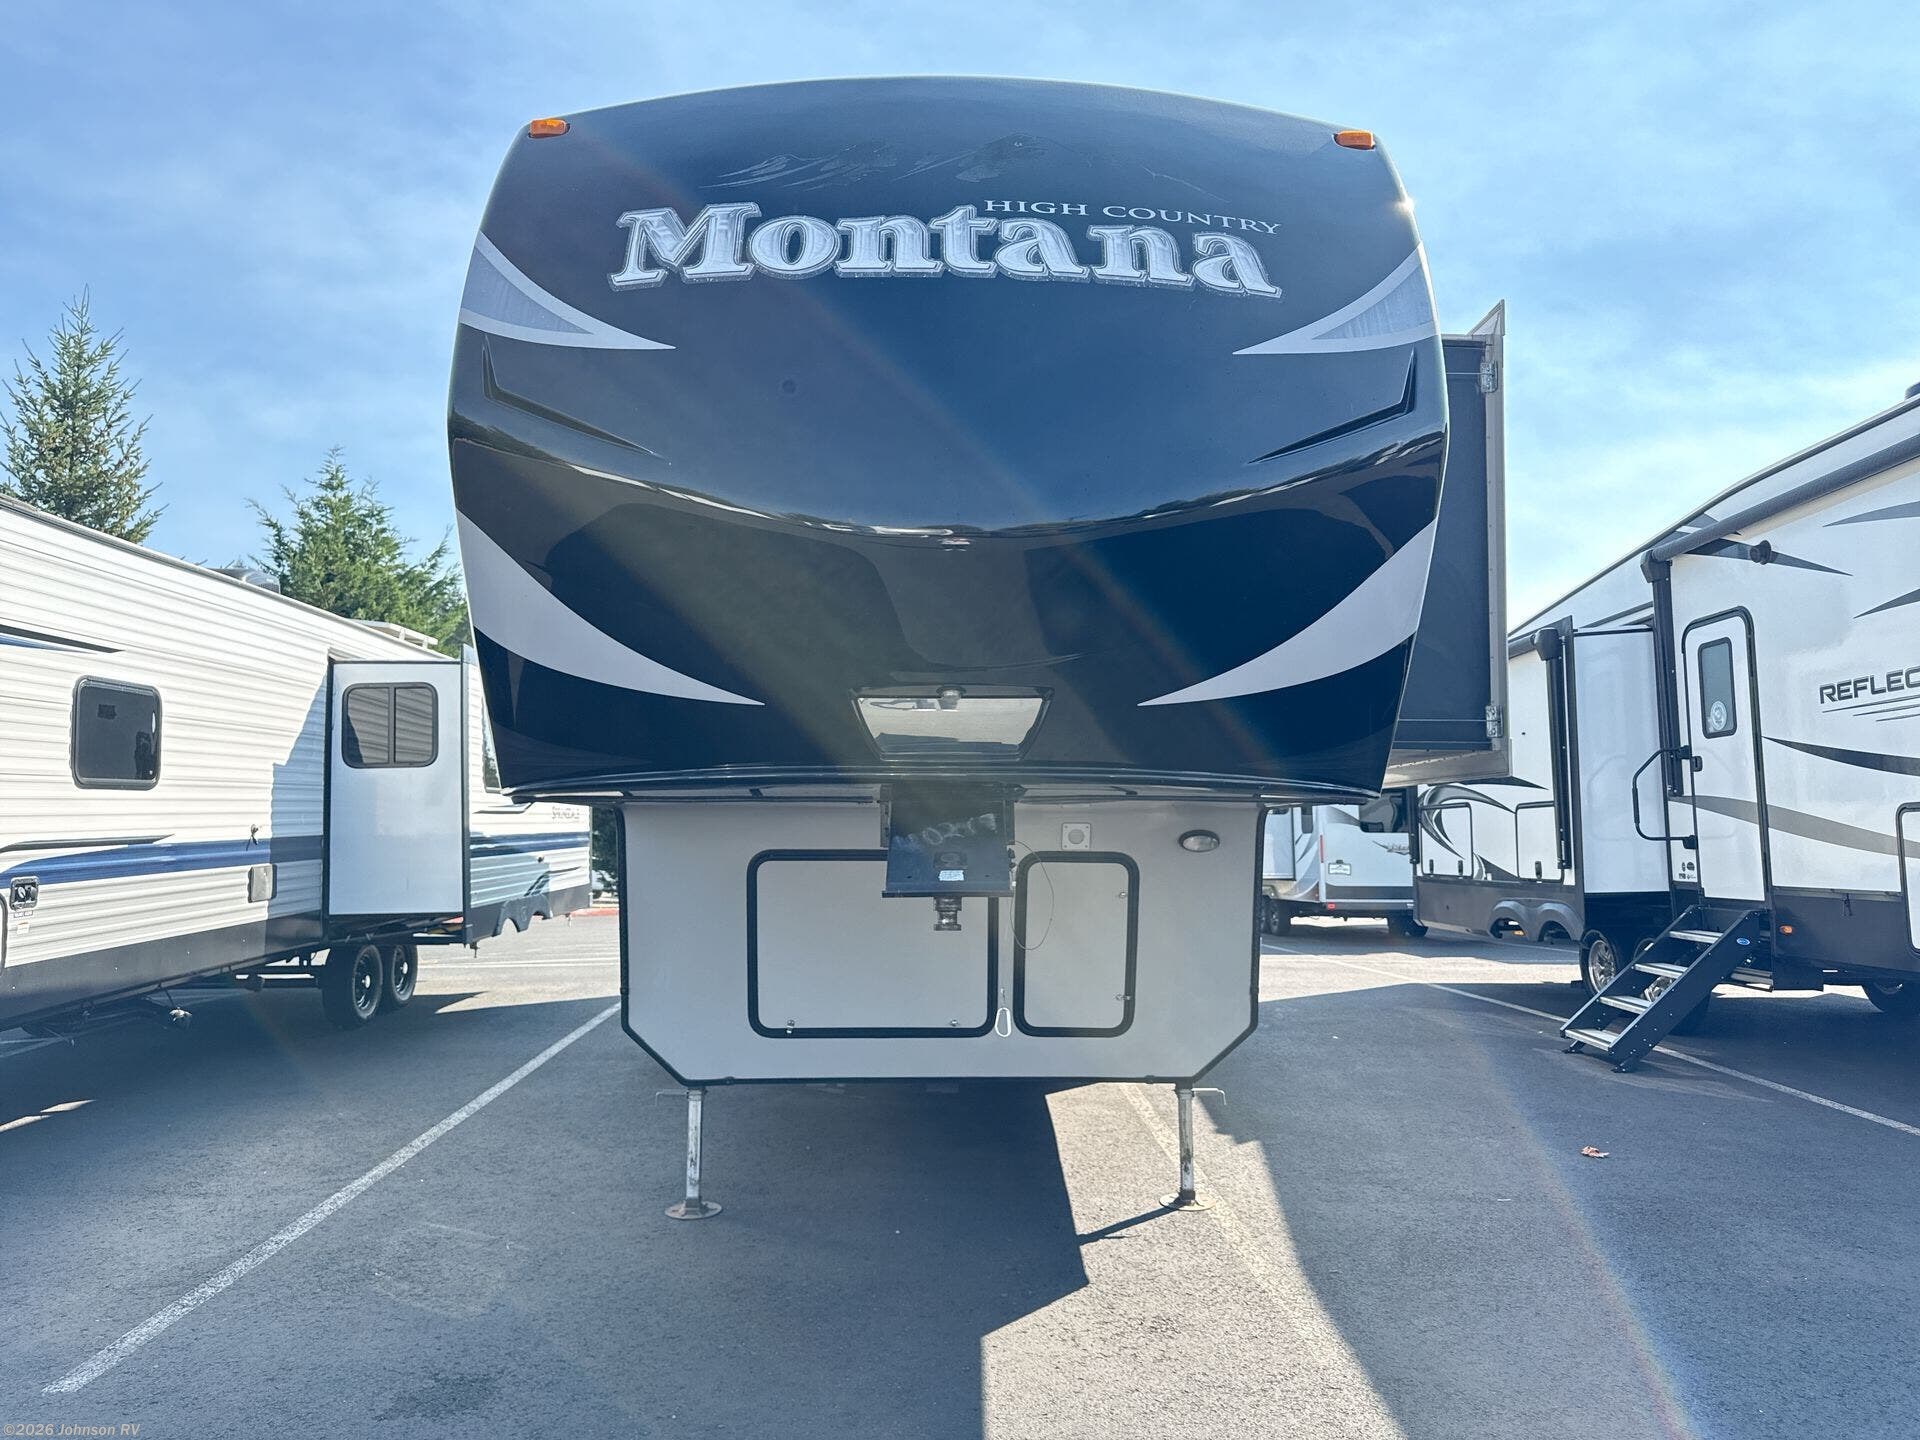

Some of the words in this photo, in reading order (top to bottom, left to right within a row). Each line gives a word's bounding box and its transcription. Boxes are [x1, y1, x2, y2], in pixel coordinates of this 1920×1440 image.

[609, 201, 1284, 299] Montana
[985, 200, 1089, 217] HIGH
[1102, 206, 1282, 235] COUNTRY
